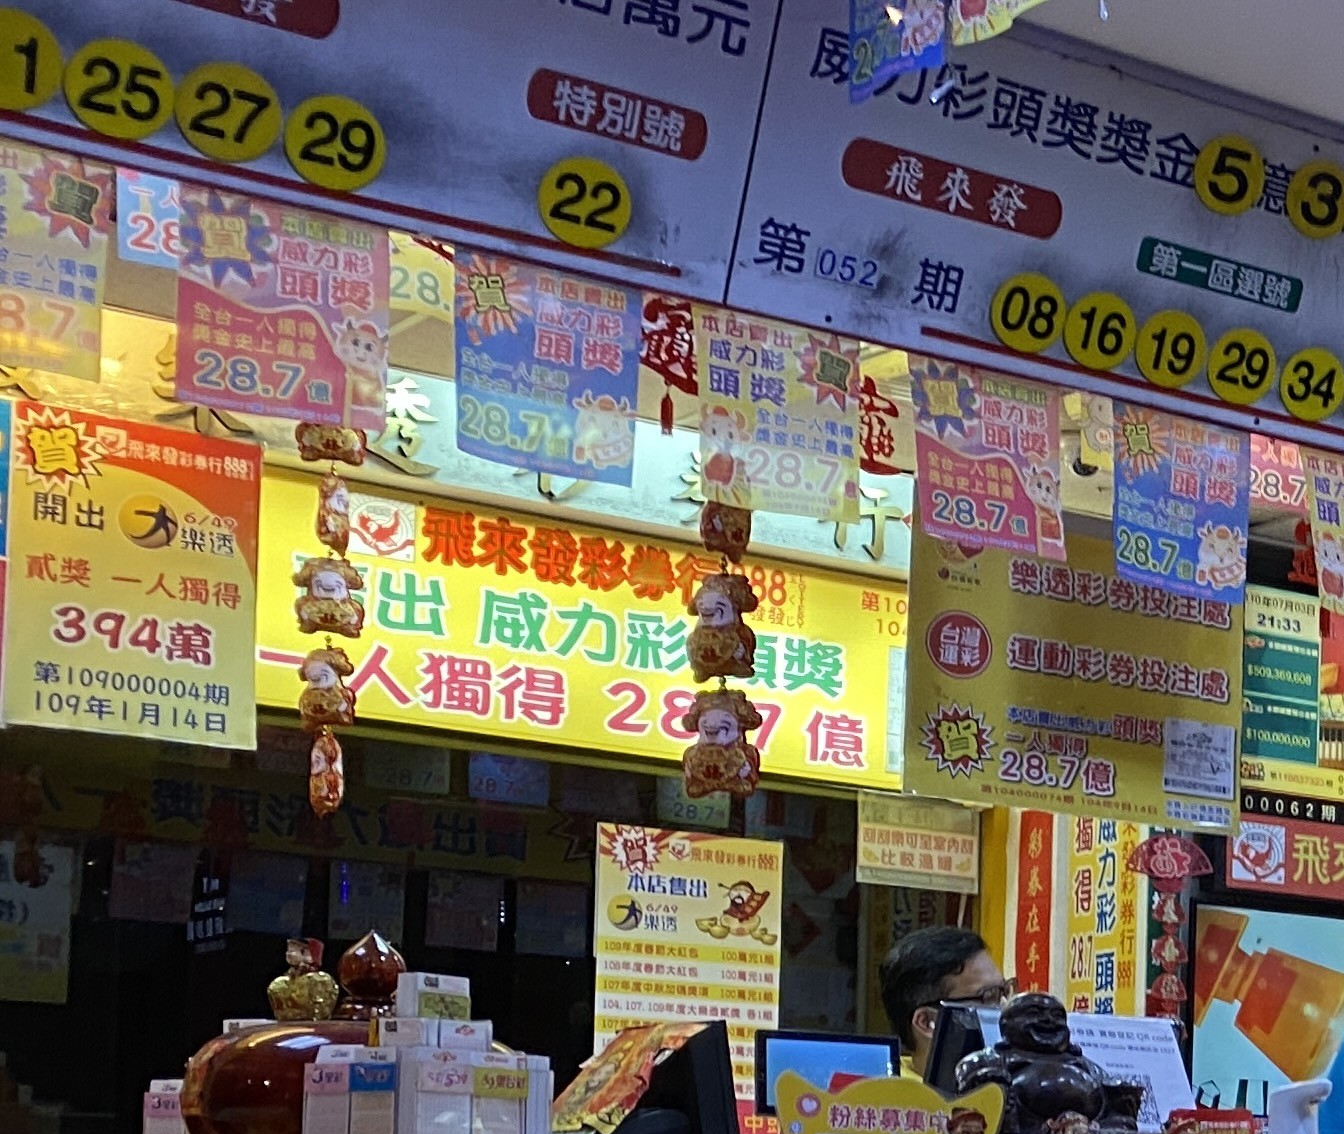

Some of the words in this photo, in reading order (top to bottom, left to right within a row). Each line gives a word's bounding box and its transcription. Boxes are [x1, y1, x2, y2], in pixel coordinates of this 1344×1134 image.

[78, 55, 162, 122] 25
[190, 80, 271, 144] 27
[298, 109, 377, 174] 29
[552, 79, 688, 153] 特別號
[548, 171, 623, 233] 22
[884, 155, 1029, 229] 飛來發
[280, 239, 372, 276] 威力彩
[752, 217, 812, 276] 第
[818, 248, 879, 288] 052
[911, 260, 965, 313] 期
[1149, 243, 1292, 310] 第一區選號
[278, 268, 373, 310] 頭獎
[468, 274, 511, 312] 賀
[538, 302, 624, 339] 威力彩
[702, 313, 794, 350] 本店賣出
[534, 330, 623, 375] 頭獎
[708, 338, 786, 372] 威力彩
[1001, 287, 1059, 338] 08
[1078, 310, 1126, 354] 16
[1151, 329, 1196, 373] 19
[1218, 346, 1270, 389] 29
[1290, 362, 1337, 404] 34
[708, 364, 786, 407] 頭獎
[981, 398, 1047, 430] 威力彩
[30, 424, 80, 475] 賀
[981, 425, 1048, 458] 頭獎
[32, 492, 105, 531] 開出
[183, 511, 236, 533] 6/49
[178, 528, 235, 556] 樂透
[25, 553, 92, 588] 貳獎
[112, 573, 241, 612] 一人獨得
[1010, 559, 1231, 629] 樂透彩券投注處
[53, 606, 214, 666] 394萬
[481, 588, 688, 668] 威力彩
[1257, 612, 1301, 633] 21:33
[32, 661, 231, 708] 第109000004期
[258, 648, 566, 727] 一人獨得
[1008, 636, 1229, 702] 運動彩券投注處
[32, 690, 228, 735] 109年1月14日
[1000, 750, 1115, 796] 28.7億
[627, 873, 708, 898] 本店售出
